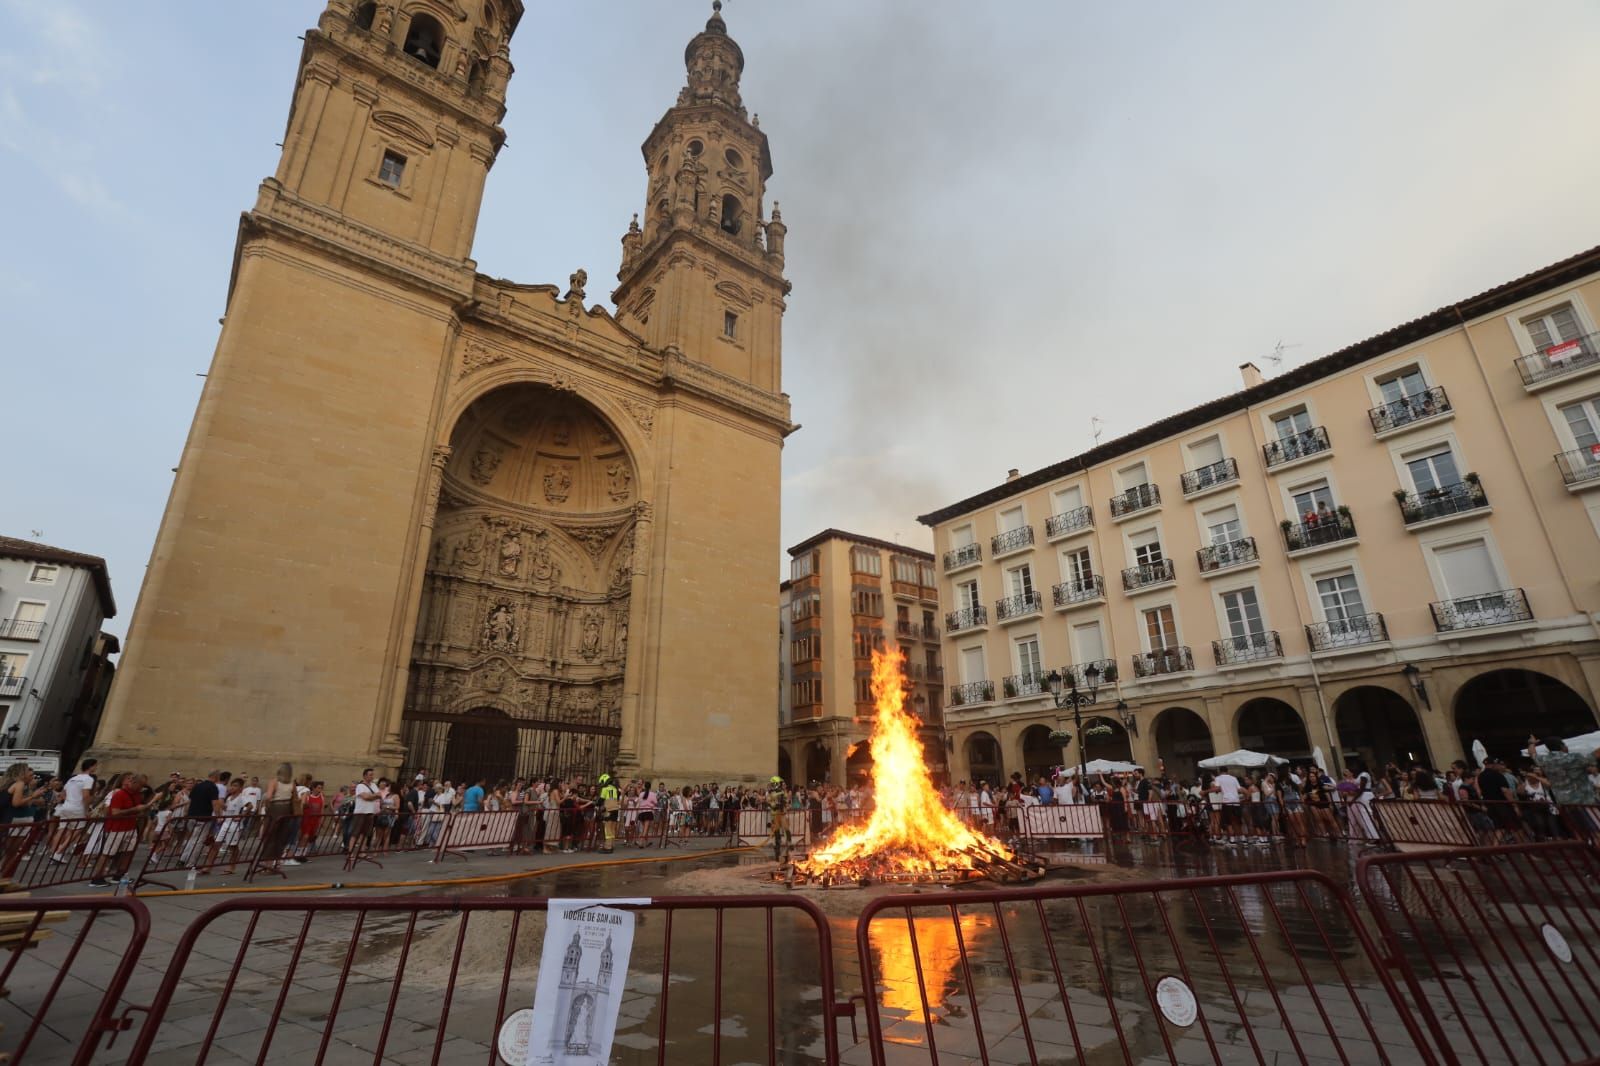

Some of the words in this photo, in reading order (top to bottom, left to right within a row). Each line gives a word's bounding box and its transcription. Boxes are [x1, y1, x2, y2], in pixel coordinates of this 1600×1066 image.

[563, 911, 586, 921] NOCHE
[587, 912, 596, 922] DE
[597, 913, 609, 923] SAN
